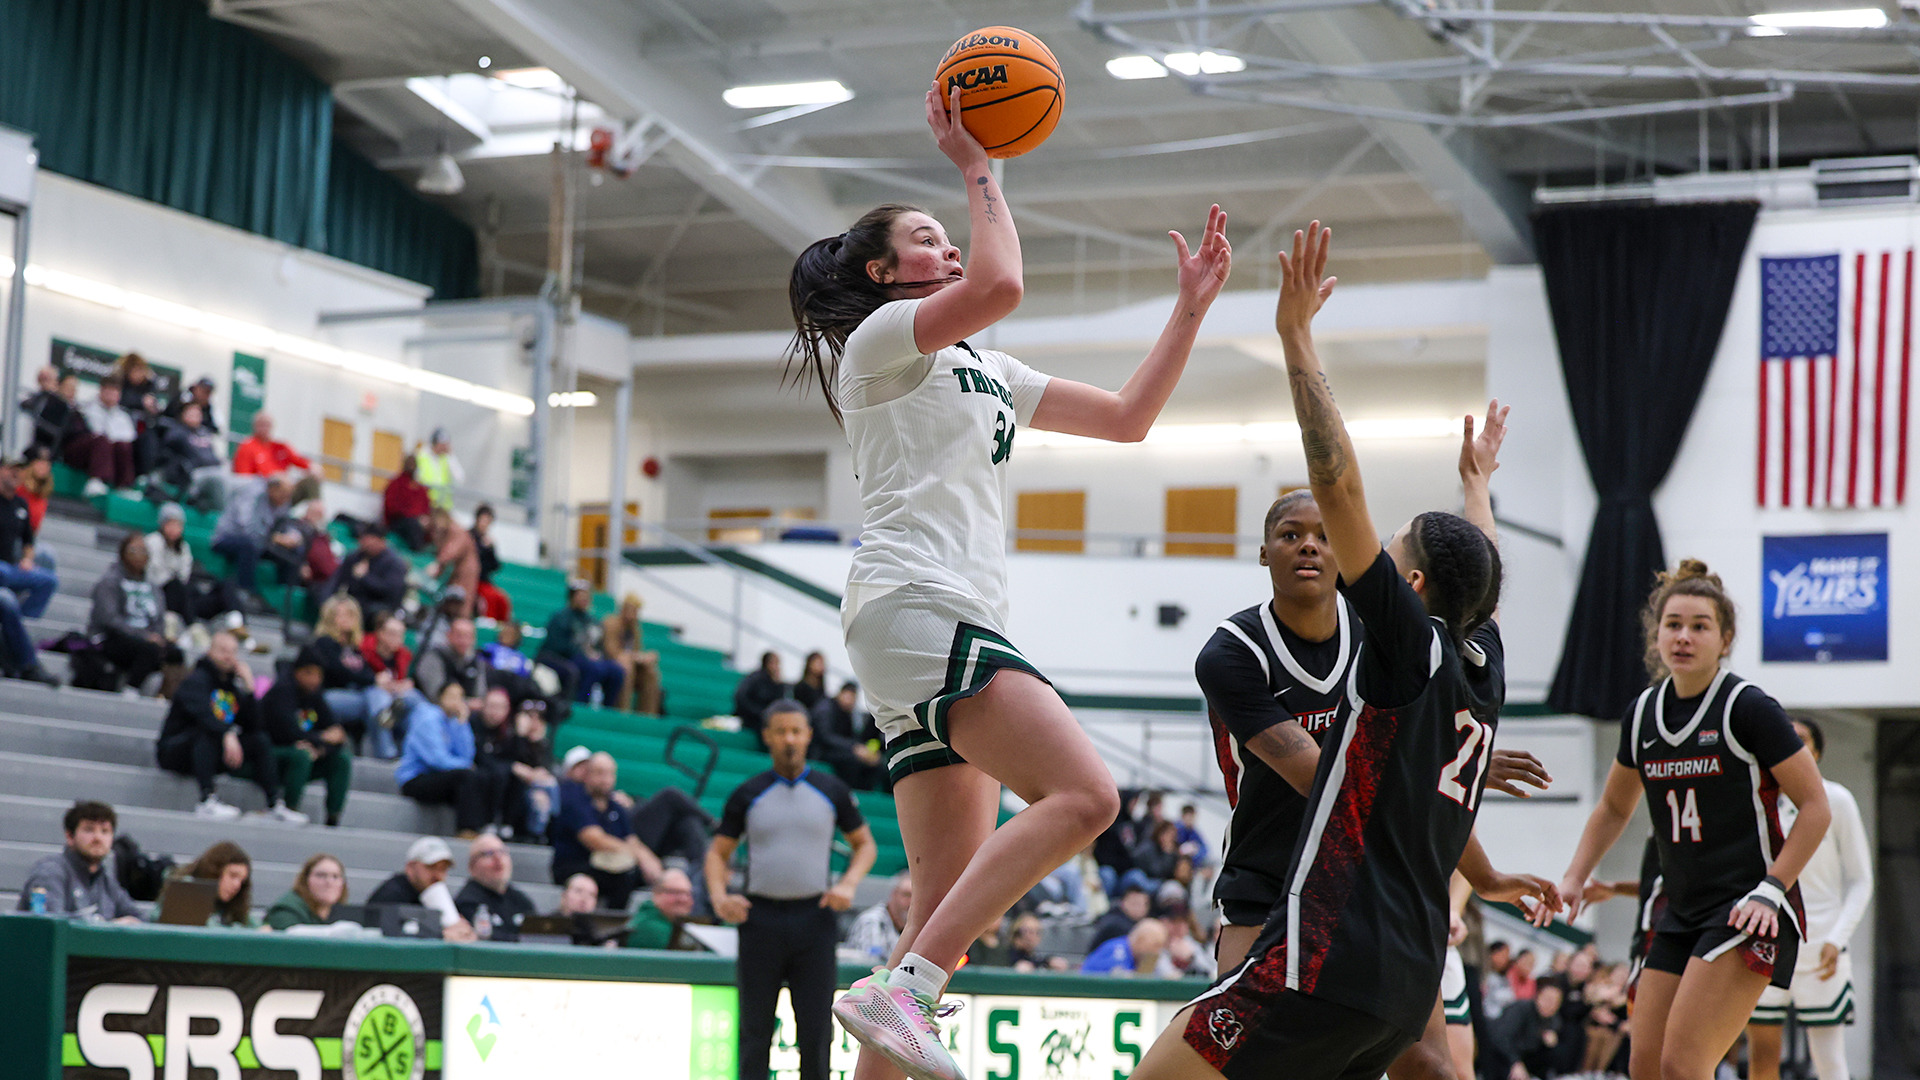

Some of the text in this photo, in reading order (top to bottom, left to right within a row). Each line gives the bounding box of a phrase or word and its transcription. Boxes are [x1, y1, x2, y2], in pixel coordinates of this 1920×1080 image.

[942, 33, 1020, 64] Wilson
[947, 64, 1008, 97] NCAA
[1768, 561, 1880, 619] YOURS
[1437, 708, 1494, 813] 21
[1643, 756, 1722, 779] CALIFORNIA
[1665, 787, 1704, 843] 14
[986, 1009, 1021, 1080] S
